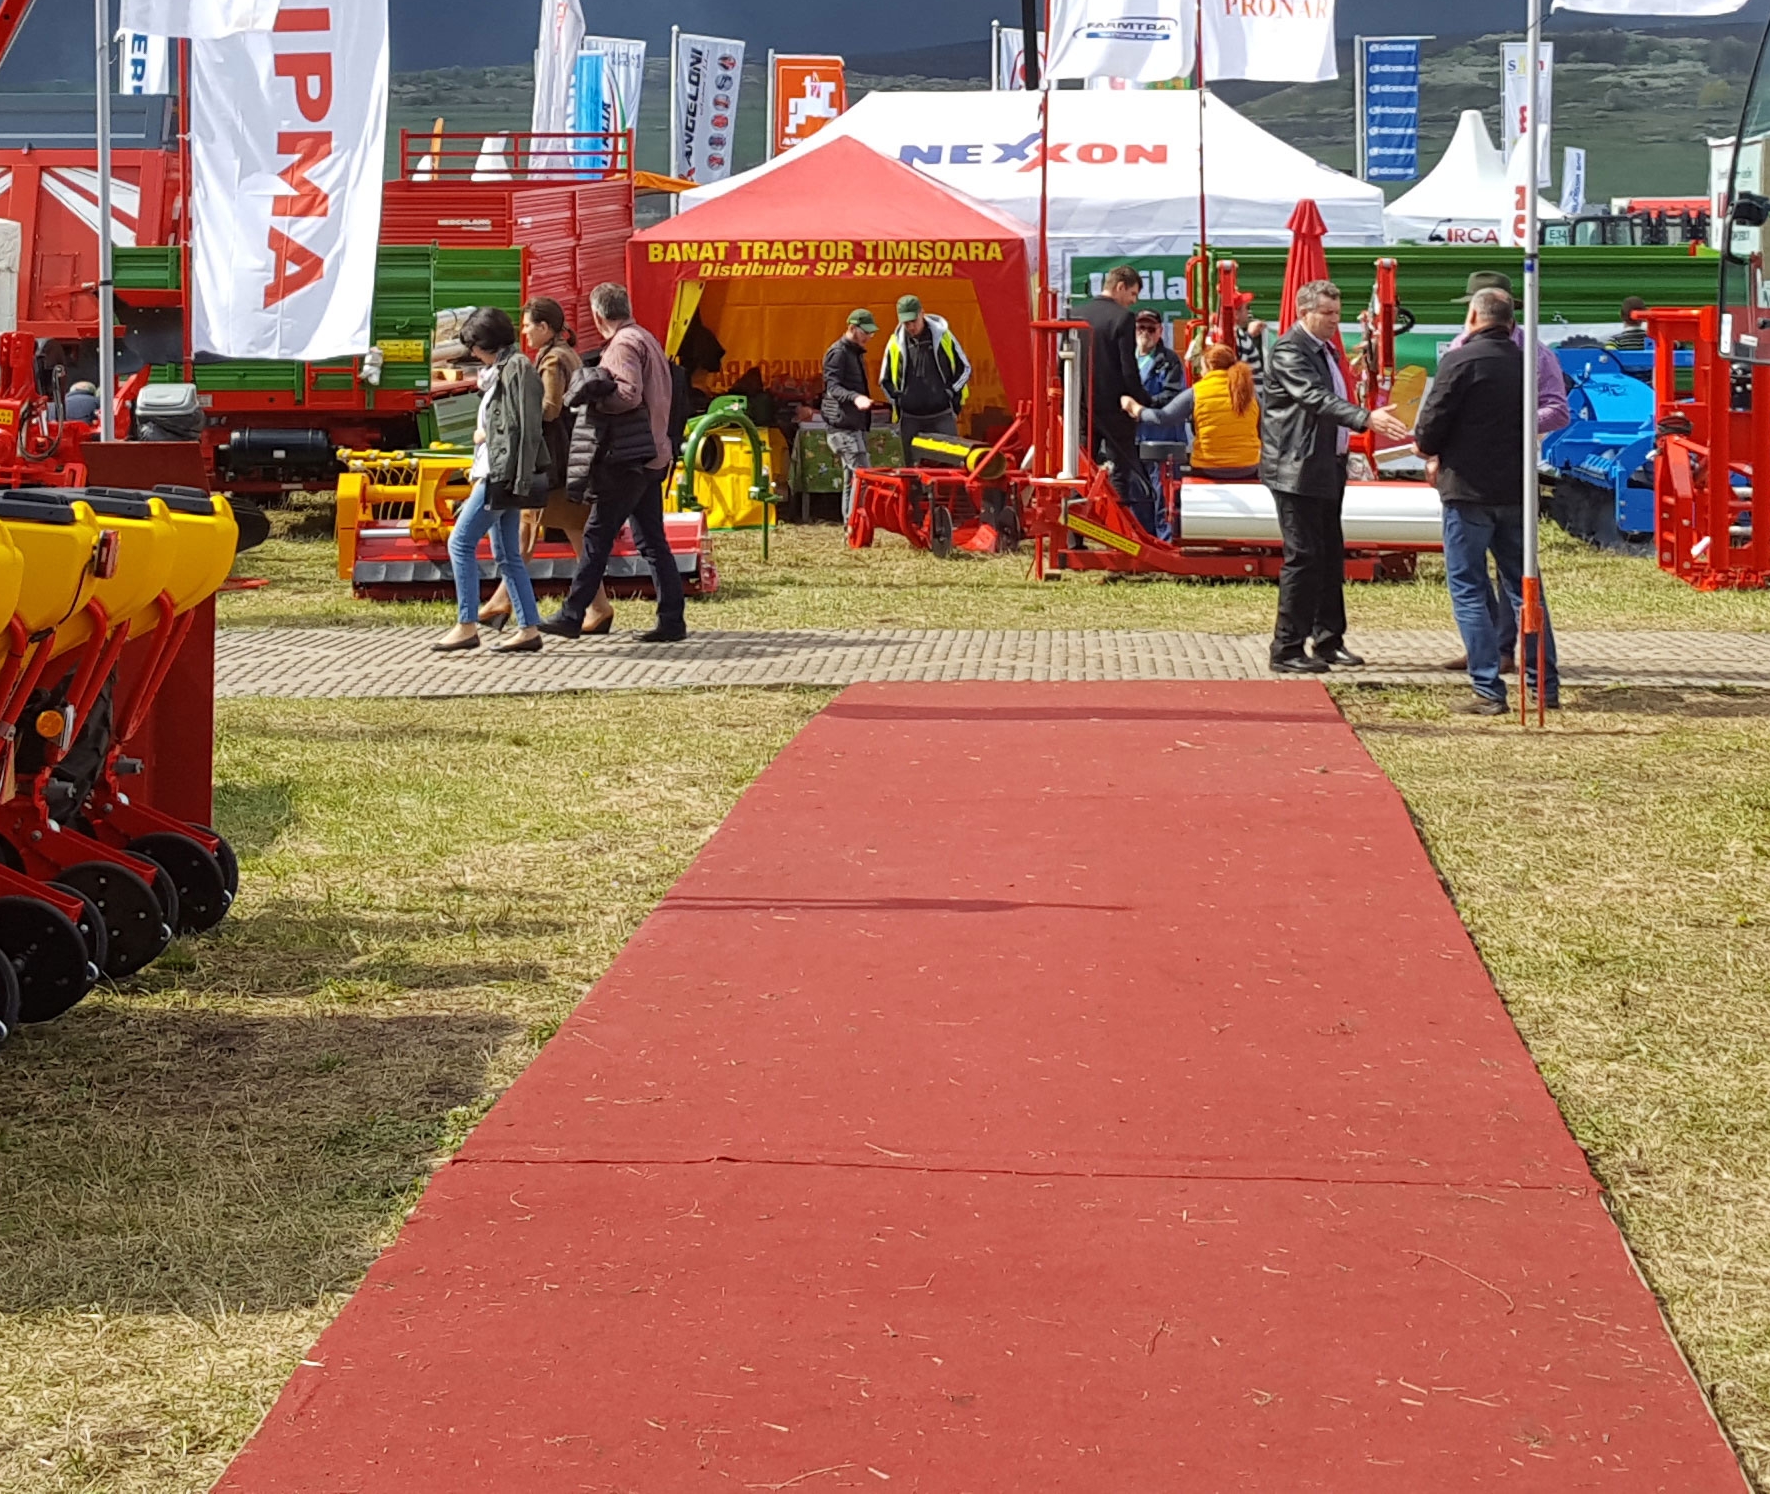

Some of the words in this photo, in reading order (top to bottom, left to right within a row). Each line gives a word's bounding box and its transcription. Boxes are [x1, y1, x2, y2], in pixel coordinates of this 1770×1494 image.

[1087, 21, 1172, 31] FARMTRA
[684, 47, 703, 166] ANGELONI
[899, 132, 1168, 172] NEXXON
[648, 241, 728, 263] BANAT
[738, 241, 853, 261] TRACTOR
[862, 241, 1003, 261] TIMISOARA
[698, 262, 810, 277] Distribuitor
[814, 261, 850, 276] SIP
[854, 262, 953, 277] SLOVENIA
